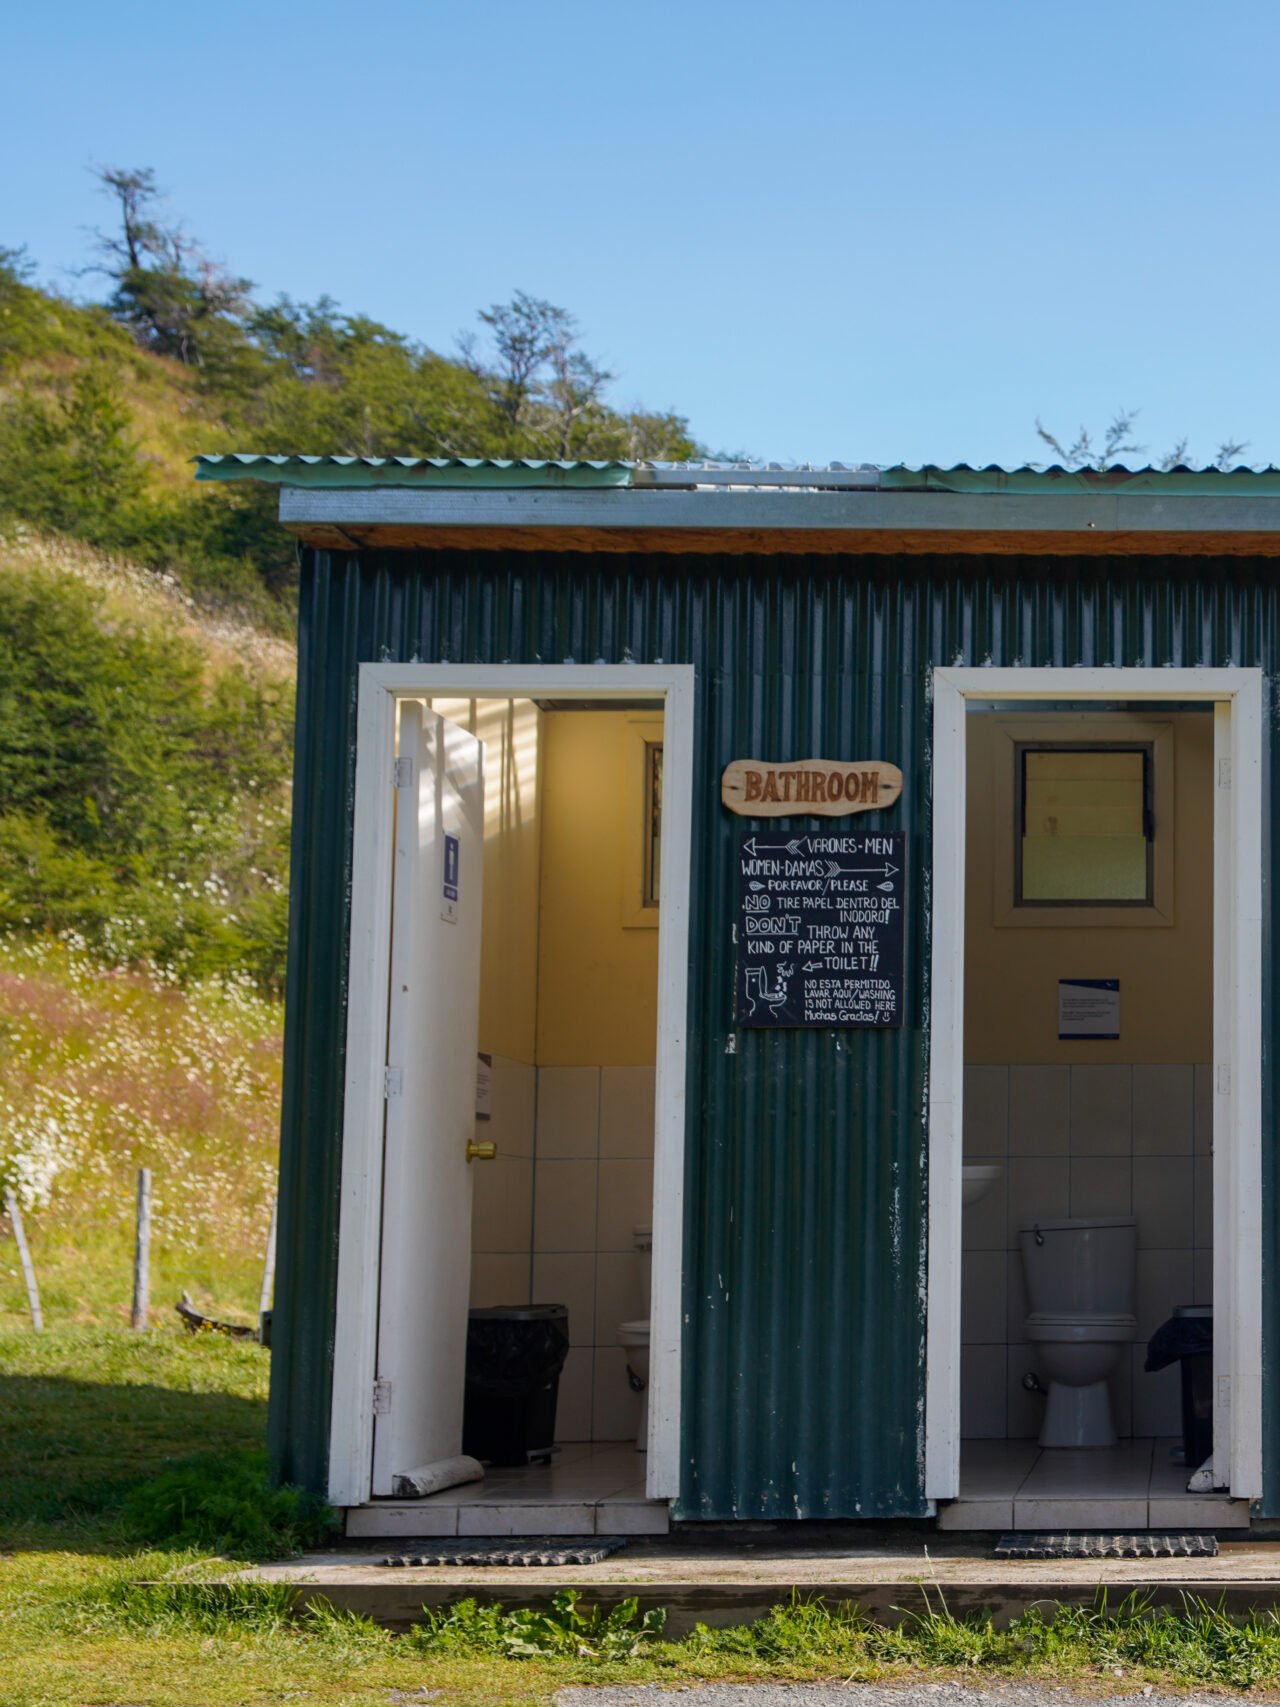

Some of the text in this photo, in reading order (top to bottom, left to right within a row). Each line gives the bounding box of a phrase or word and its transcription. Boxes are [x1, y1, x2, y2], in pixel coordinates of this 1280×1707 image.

[744, 771, 879, 803] BATHROOM
[745, 895, 900, 910] NO TIRE PAPEL DENTRO DEL
[840, 910, 890, 924] INODORO!
[746, 914, 875, 940] DON'T THROW ANY
[748, 940, 879, 954] KIND OF PAPER IN THE
[804, 980, 890, 989] NO ESTA PERMITIDO
[804, 990, 830, 998] LAVAR
[806, 999, 896, 1010] IS NOT ALLOWED HERE
[804, 1010, 879, 1023] Muchas Gracias!
